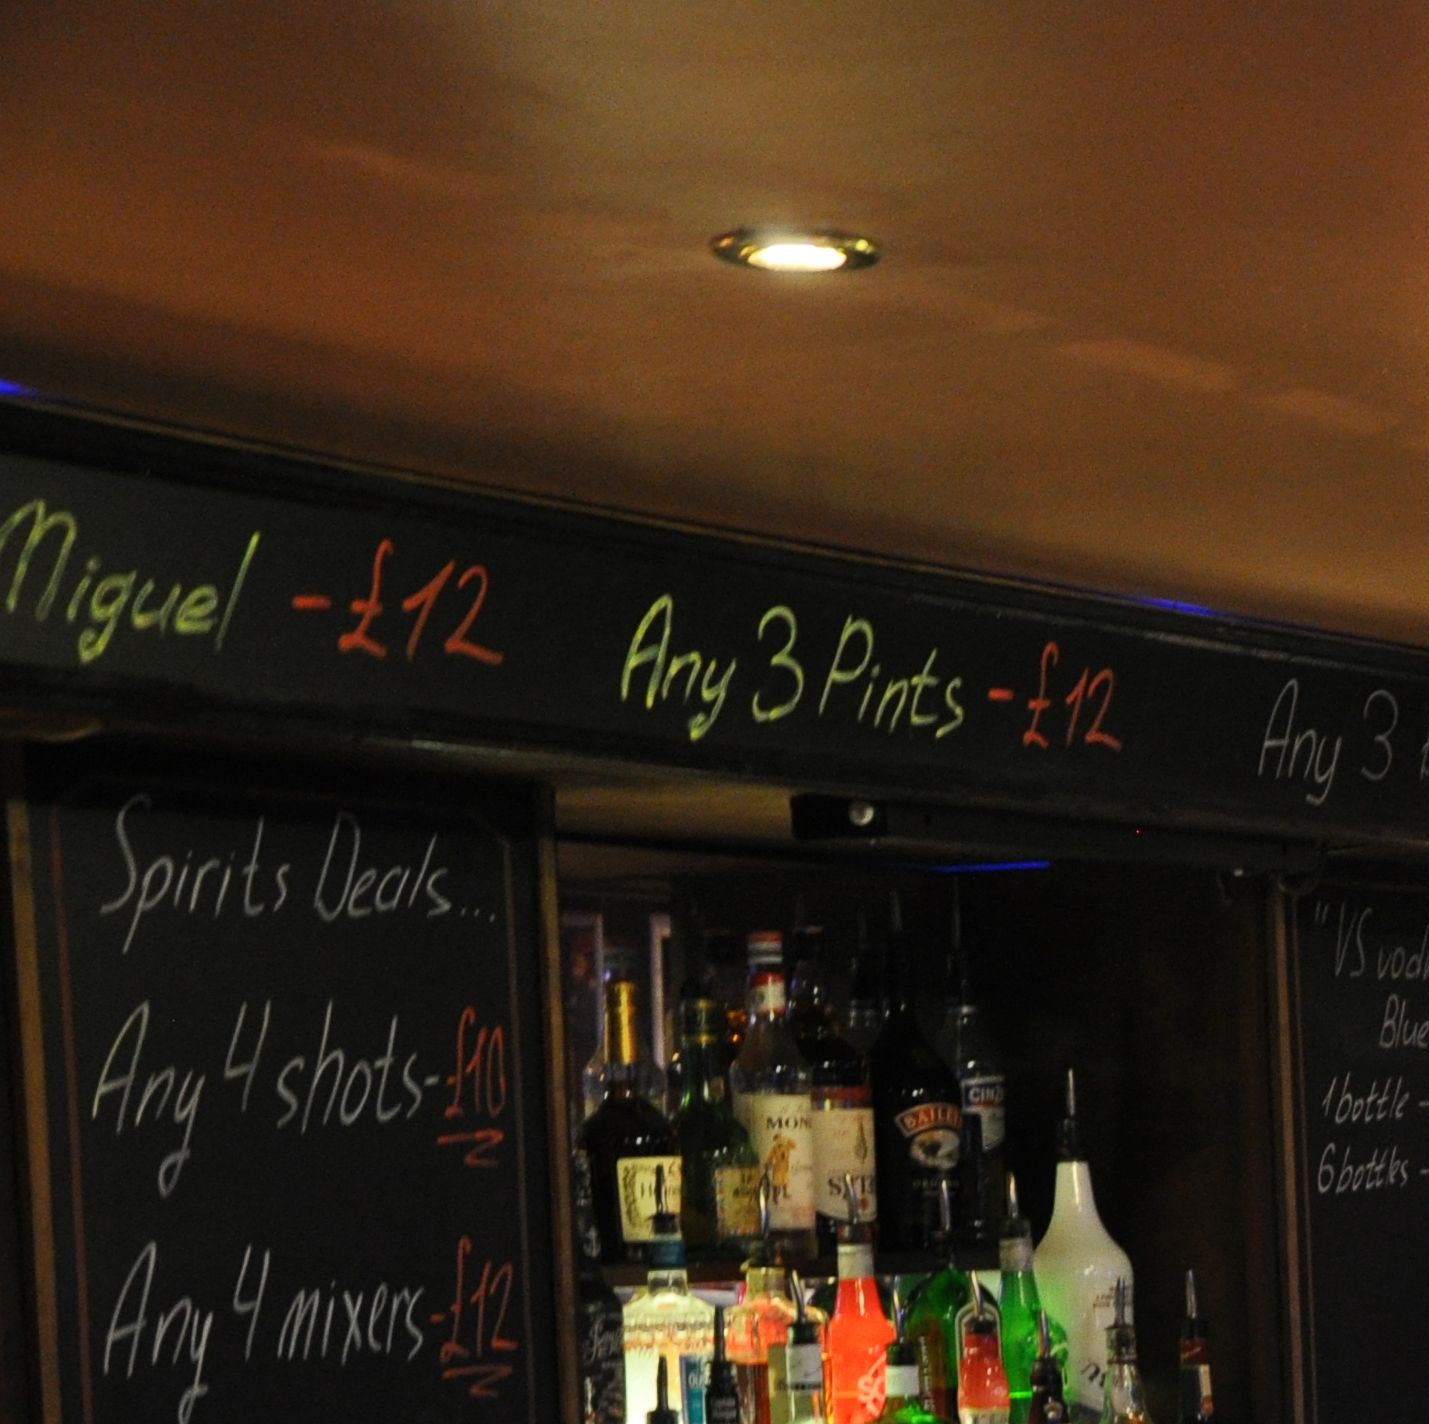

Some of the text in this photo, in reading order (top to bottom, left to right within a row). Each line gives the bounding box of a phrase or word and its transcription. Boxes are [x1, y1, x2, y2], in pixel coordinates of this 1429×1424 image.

[0, 499, 259, 665] Miguel
[621, 594, 736, 742] Any
[752, 605, 804, 722] 3
[819, 613, 965, 739] Pints
[1257, 677, 1341, 806] Any
[1361, 689, 1399, 781] 3
[100, 794, 291, 955] Spirits
[92, 1000, 206, 1197] Any
[223, 1002, 271, 1112] 4
[1335, 1071, 1411, 1124] bottle
[1318, 1142, 1336, 1194] 6
[1336, 1146, 1409, 1194] bottles
[232, 1244, 271, 1361] 4
[278, 1279, 425, 1366] mixers
